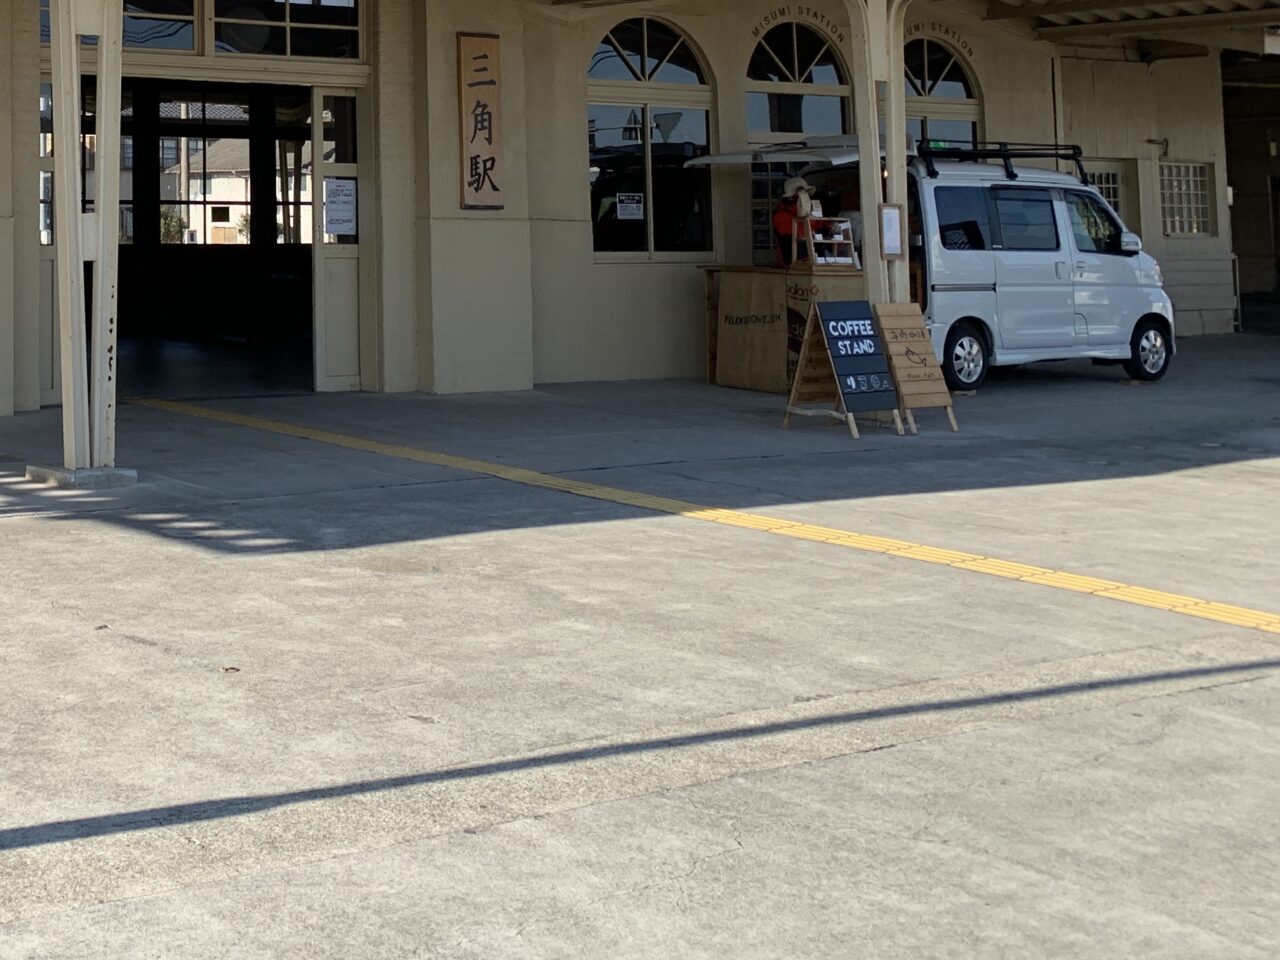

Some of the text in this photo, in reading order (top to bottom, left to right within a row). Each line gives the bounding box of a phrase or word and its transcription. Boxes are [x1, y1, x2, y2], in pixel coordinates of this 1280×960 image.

[752, 6, 844, 43] MISUMI STATION
[931, 22, 974, 57] STATION
[467, 54, 501, 194] 三角駅
[829, 320, 874, 336] COFFEE
[838, 340, 875, 355] STAND
